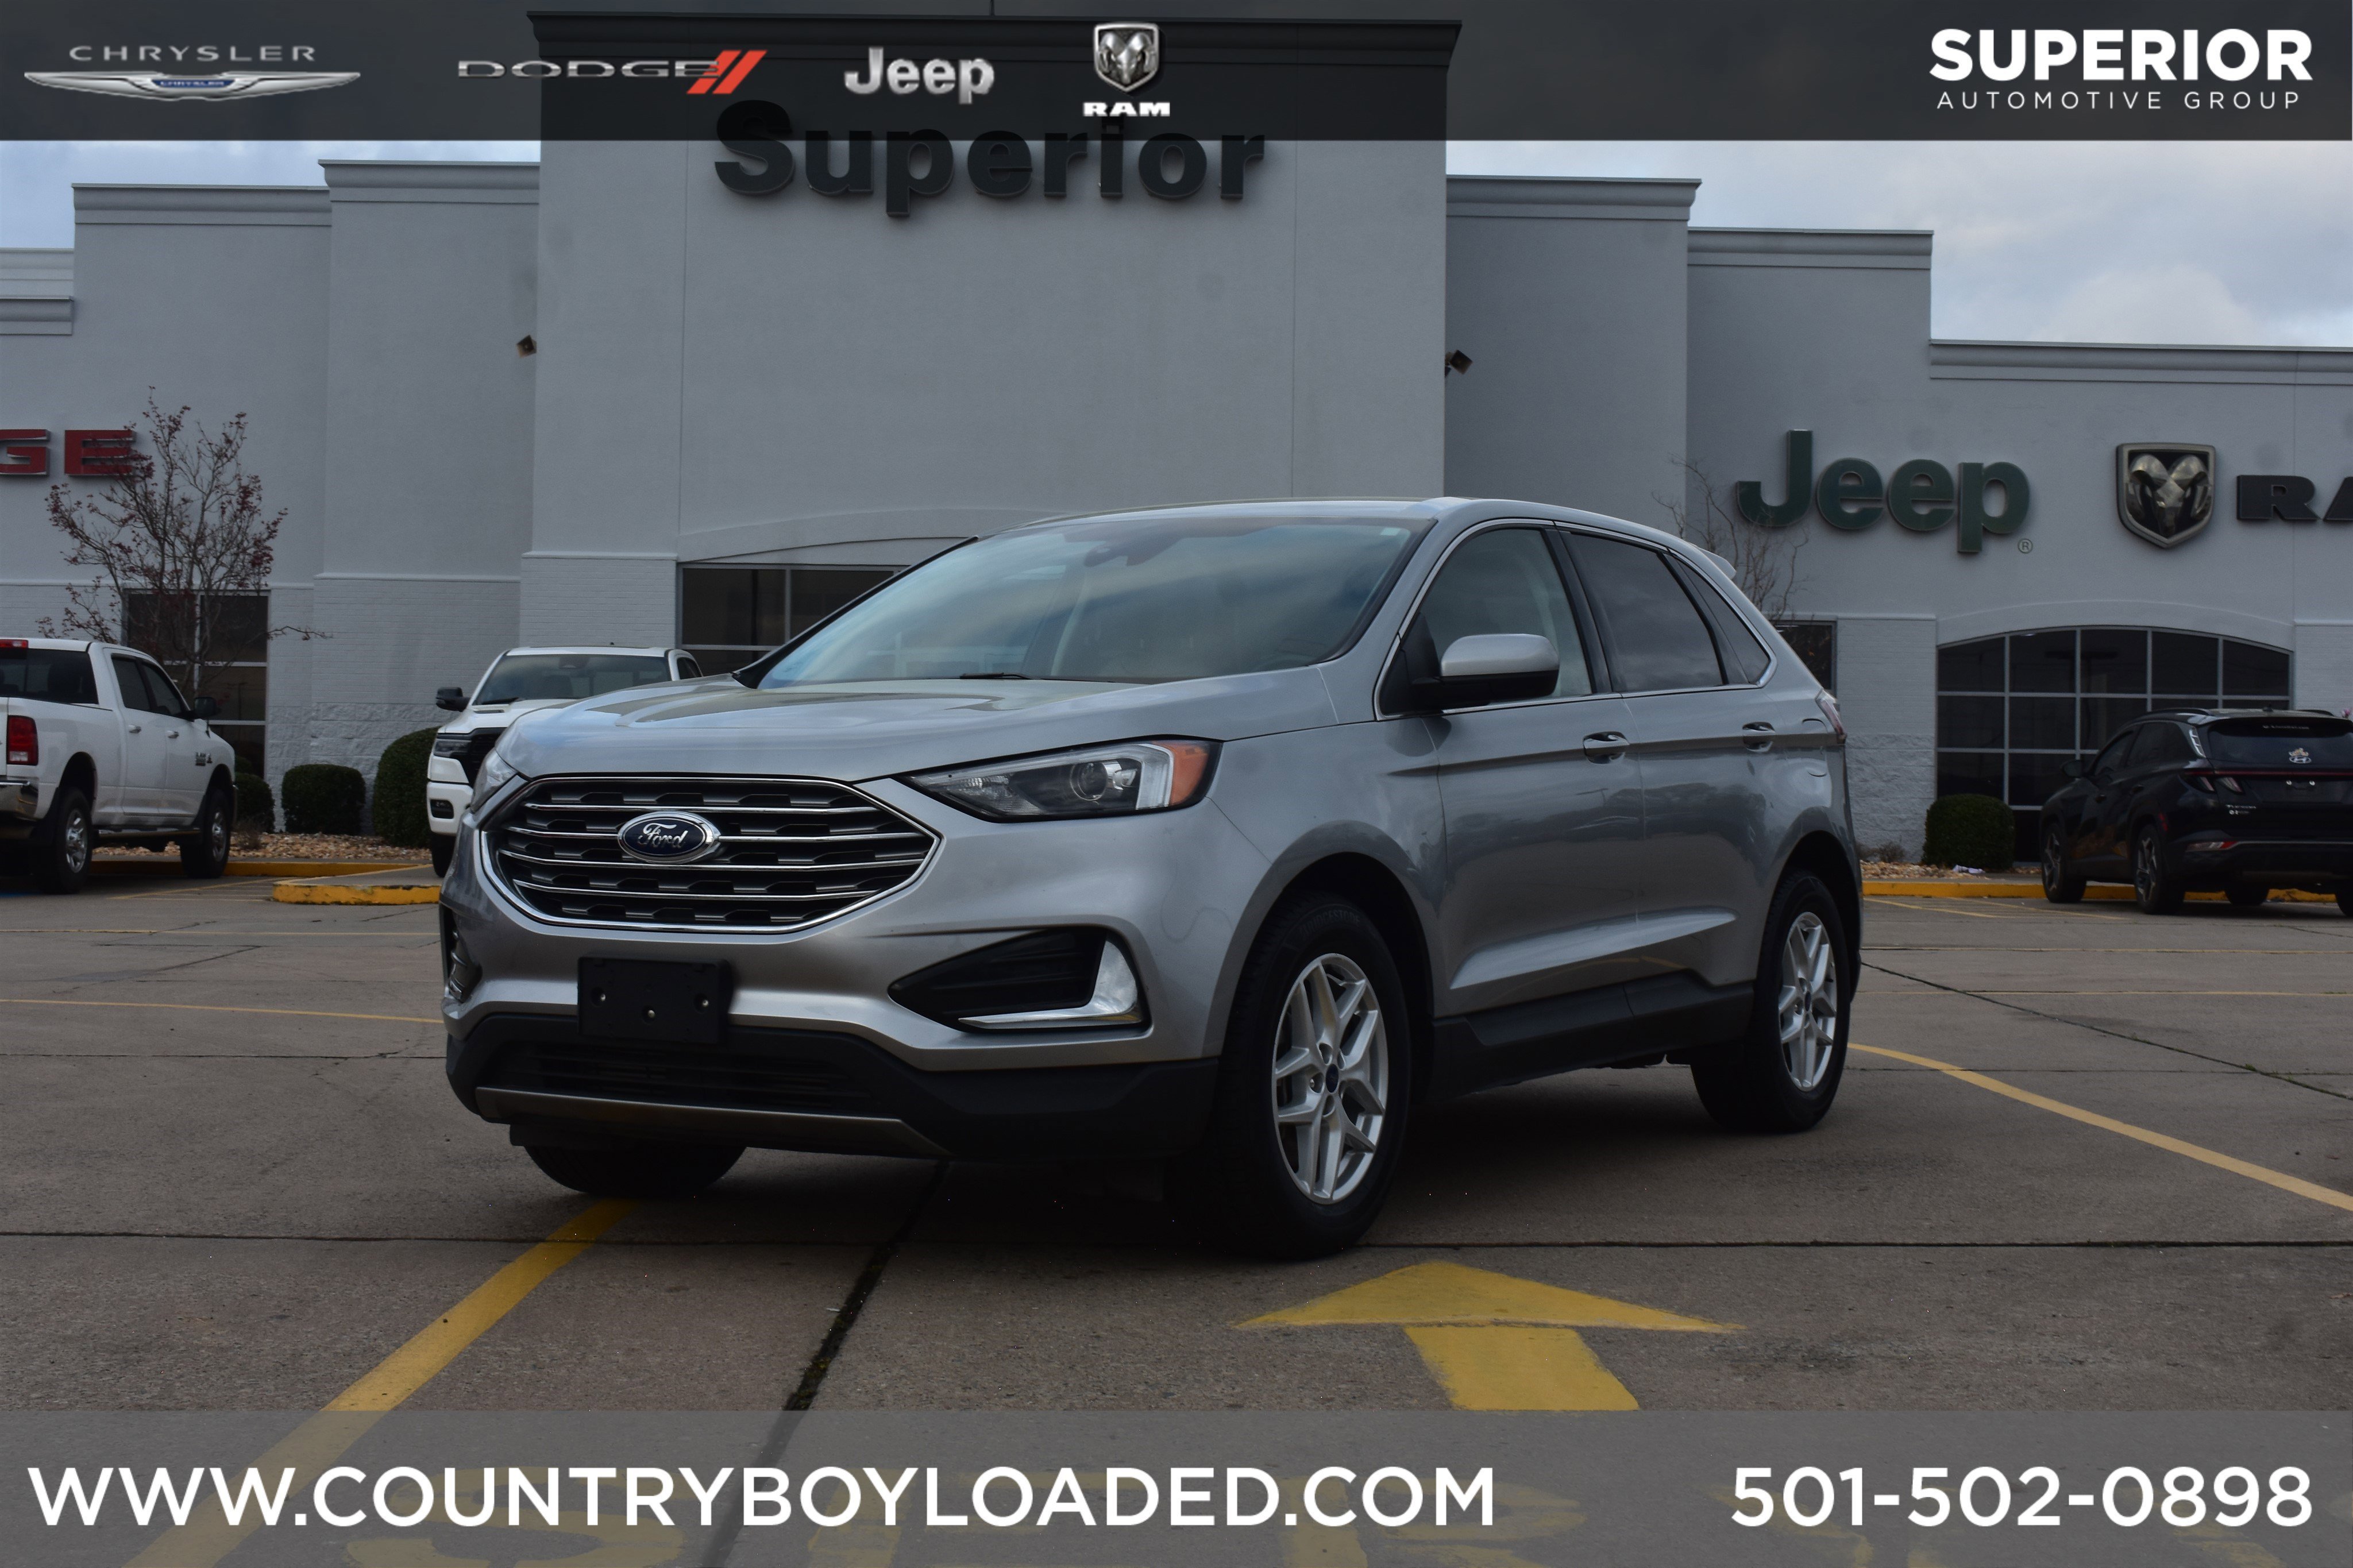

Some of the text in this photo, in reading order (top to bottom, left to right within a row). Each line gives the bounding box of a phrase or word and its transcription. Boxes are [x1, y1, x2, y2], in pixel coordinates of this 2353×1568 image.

[715, 99, 1265, 218] Superior
[1735, 428, 2031, 553] Jeep
[638, 822, 689, 849] Ford
